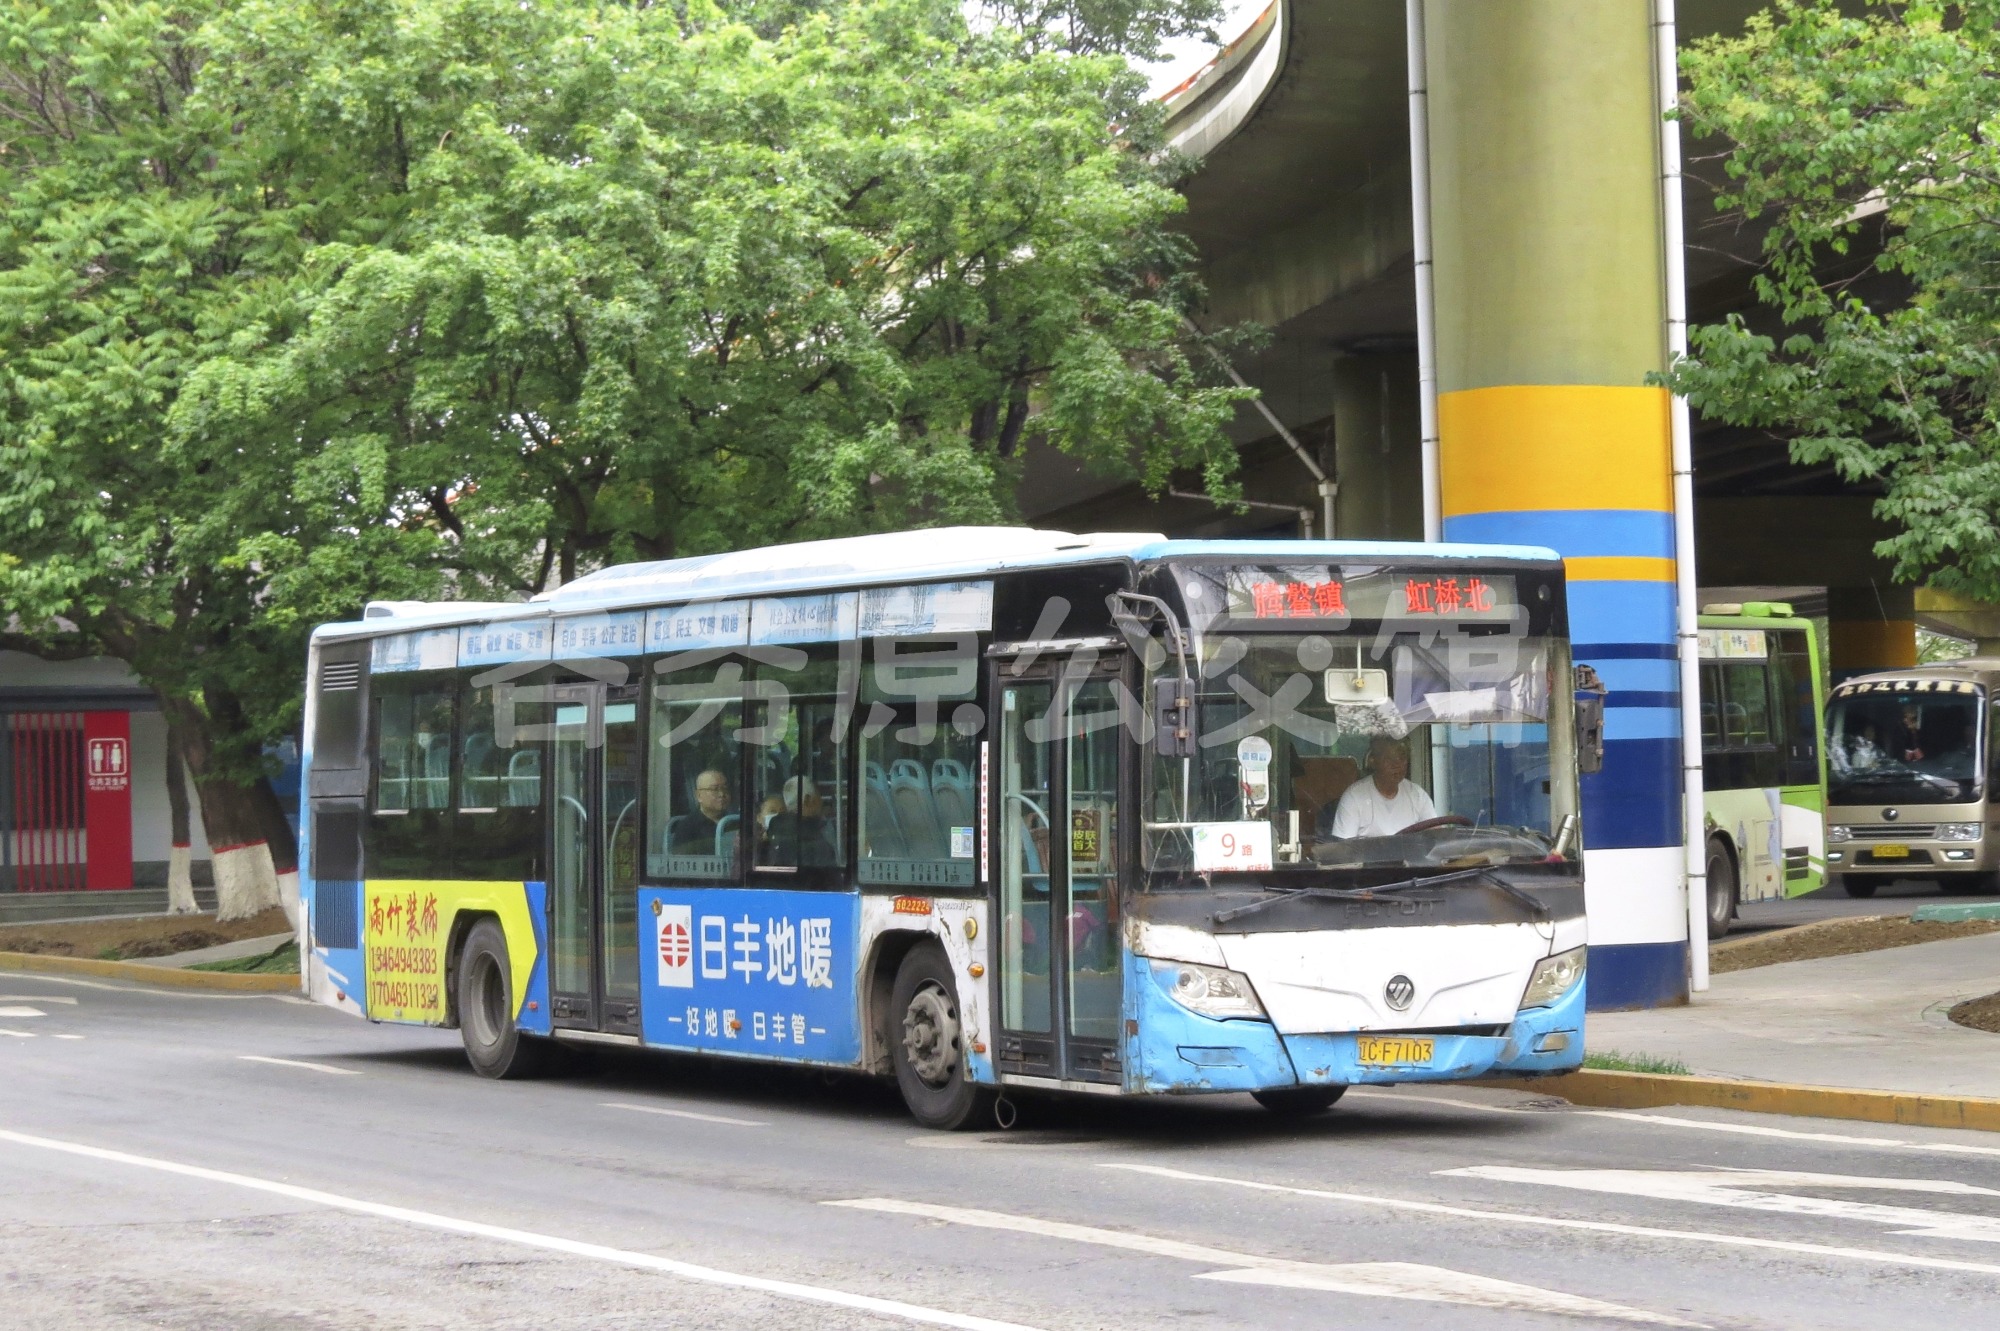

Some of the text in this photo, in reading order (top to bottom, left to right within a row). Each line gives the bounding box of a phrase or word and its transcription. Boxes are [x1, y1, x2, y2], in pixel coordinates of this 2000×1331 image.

[1252, 579, 1492, 618] 腾鳌镇 虹桥北
[601, 625, 616, 645] 公正
[621, 624, 637, 643] 法治
[676, 617, 692, 638] 民主
[698, 616, 716, 636] 文明
[721, 613, 739, 633] 和谐
[371, 946, 438, 974] 13464943383
[700, 914, 833, 989] 日丰地暖
